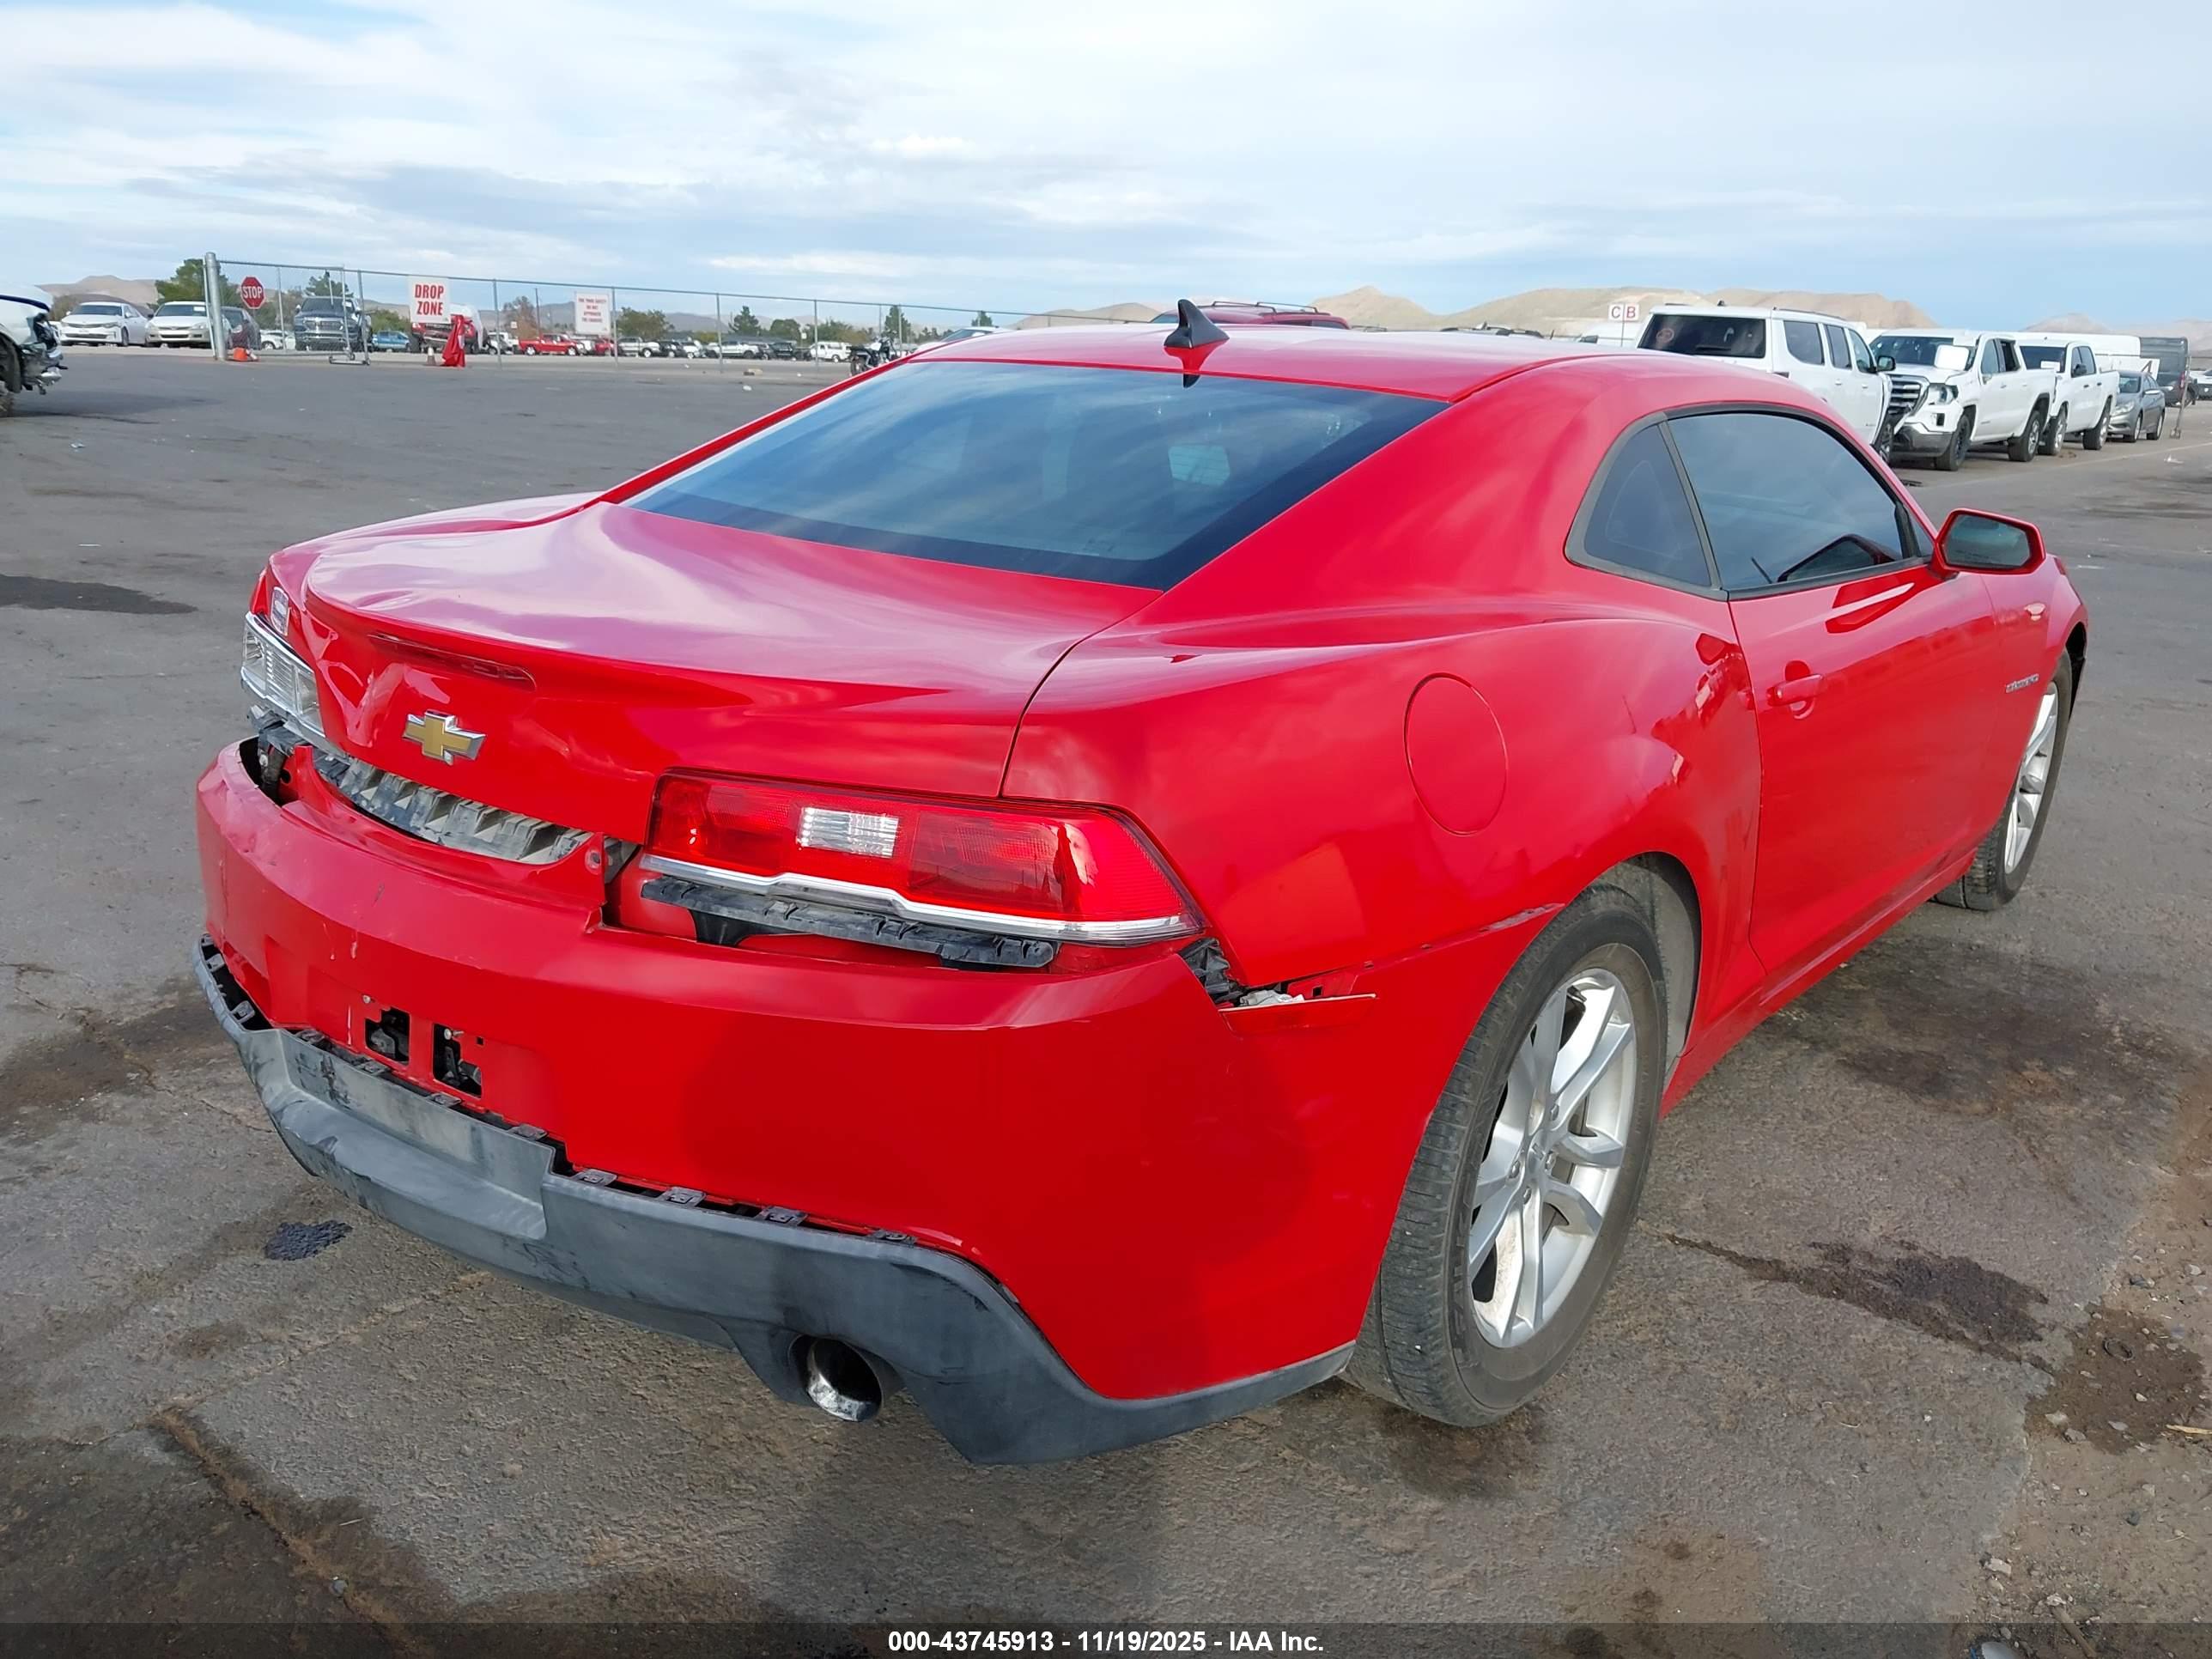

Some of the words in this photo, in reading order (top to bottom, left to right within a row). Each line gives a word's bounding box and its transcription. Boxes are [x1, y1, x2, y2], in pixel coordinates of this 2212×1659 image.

[243, 286, 263, 299] STOP
[415, 284, 444, 299] DROP
[416, 301, 443, 315] ZONE
[1612, 306, 1620, 319] C
[1626, 306, 1636, 319] B
